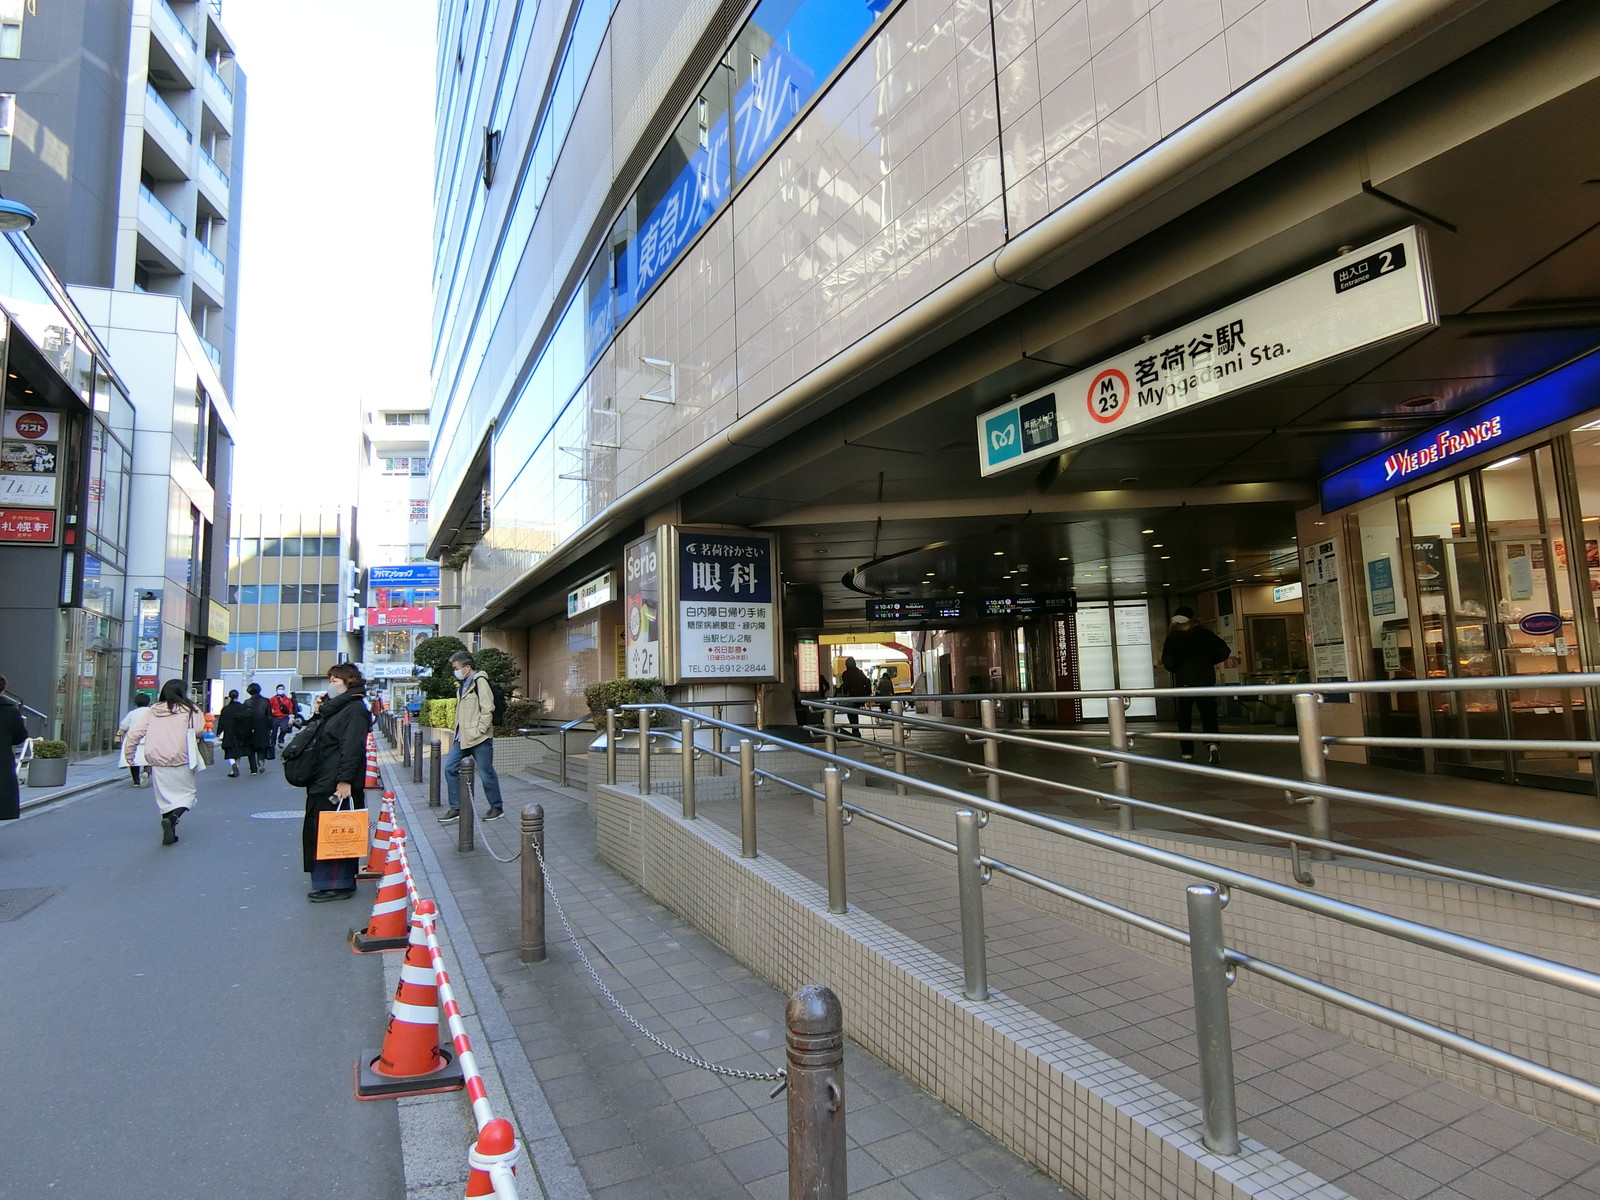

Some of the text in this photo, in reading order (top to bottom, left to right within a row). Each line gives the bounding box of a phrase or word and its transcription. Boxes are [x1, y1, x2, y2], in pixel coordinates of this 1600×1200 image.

[1378, 251, 1395, 274] 2
[1339, 261, 1369, 282] 出入口
[1340, 273, 1370, 290] Entrance
[1134, 318, 1246, 388] 茗荷谷駅
[1137, 342, 1291, 408] Myogadani Sta.
[1100, 377, 1115, 395] M
[1098, 393, 1119, 413] 23
[20, 423, 45, 432] ガスト
[1023, 411, 1054, 430] 東京メトロ
[1418, 443, 1438, 467] DE
[1437, 415, 1502, 459] FRANCE
[1, 521, 49, 533] 札幌軒
[700, 543, 764, 558] 茗荷谷かさい
[627, 546, 657, 581] Seria
[373, 569, 414, 578] アパマンショップ
[692, 561, 759, 594] 眼科
[686, 606, 766, 619] 白内障日帰り手術
[687, 620, 766, 631] 糖尿病網膜症・緑内障
[703, 633, 752, 644] 当駅ビル2階
[714, 645, 742, 654] 祝日診療
[641, 648, 653, 675] 2F
[688, 664, 767, 673] TEL 03-6912-2844
[386, 667, 411, 675] SoftBa
